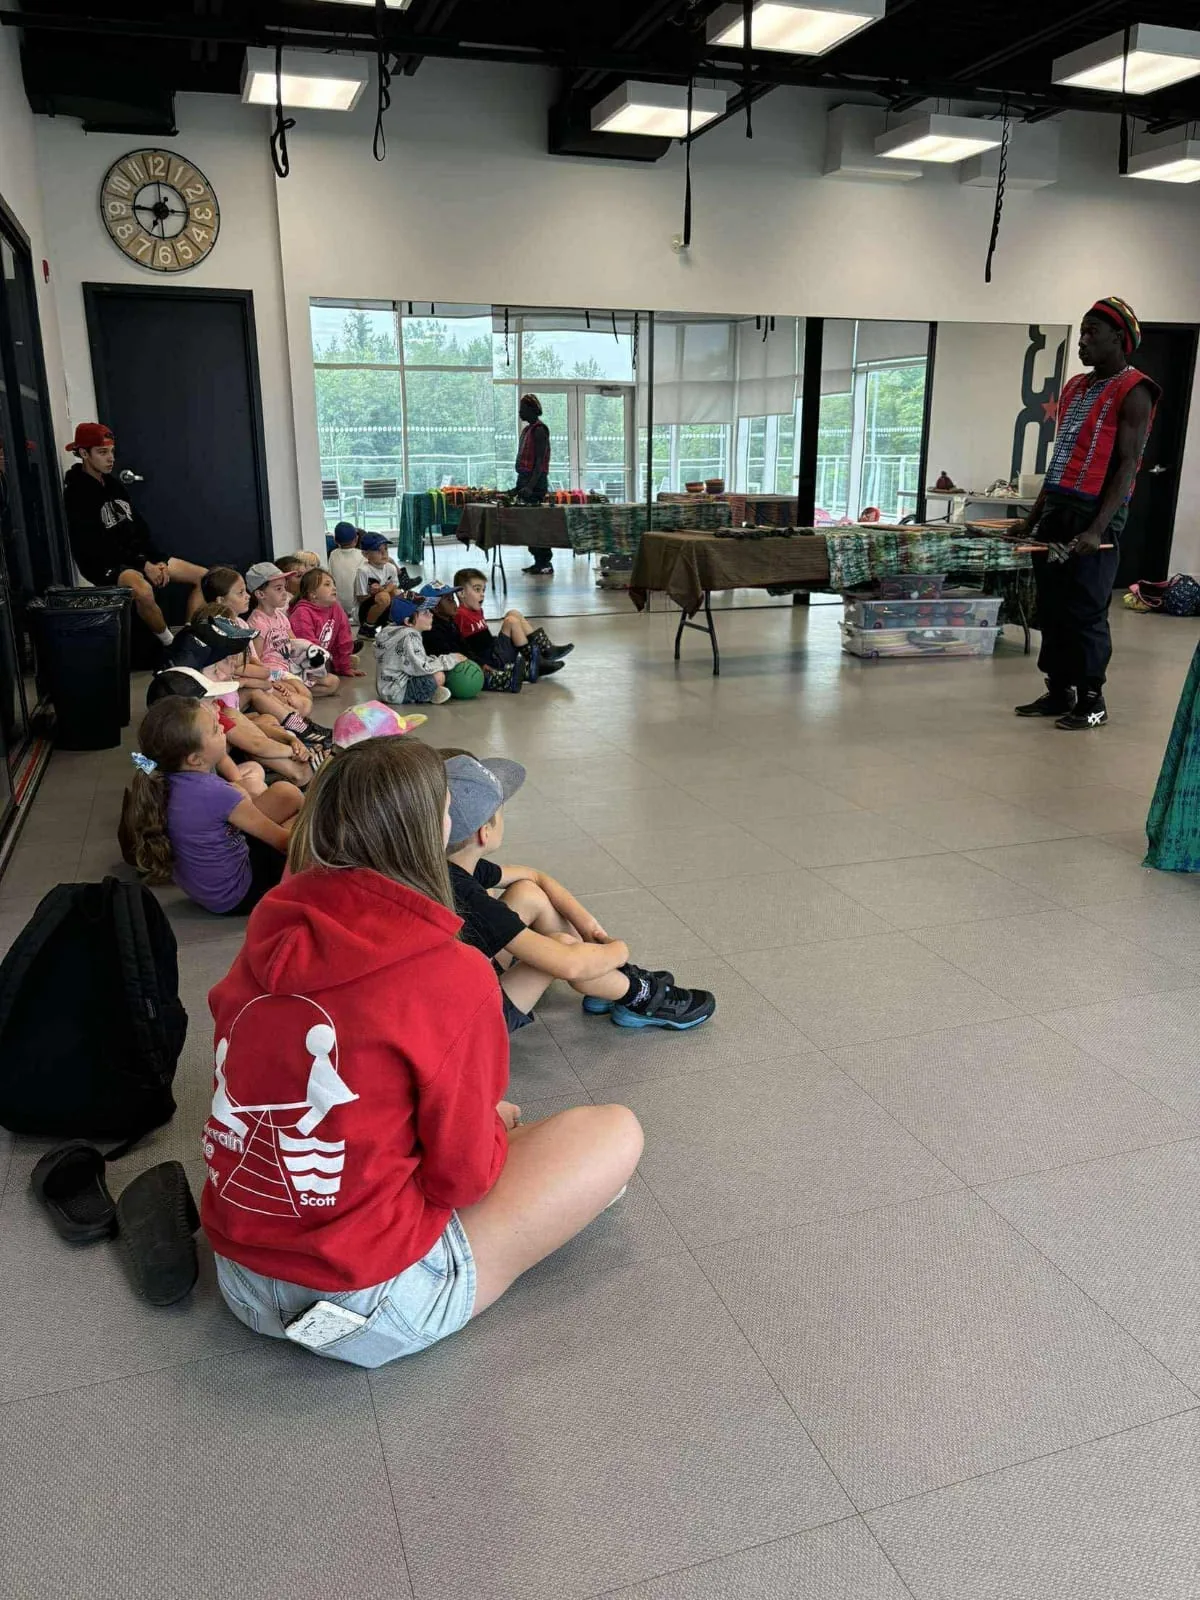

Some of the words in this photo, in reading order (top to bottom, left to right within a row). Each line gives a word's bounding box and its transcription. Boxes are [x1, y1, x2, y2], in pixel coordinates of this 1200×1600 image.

[128, 160, 144, 181] 11
[148, 156, 166, 176] 12
[174, 166, 185, 182] 1
[110, 175, 131, 196] 10
[185, 183, 205, 201] 2
[108, 201, 126, 215] 9
[194, 207, 212, 220] 3
[117, 223, 133, 239] 8
[191, 227, 209, 242] 4
[136, 238, 152, 256] 7
[159, 246, 172, 264] 6
[176, 240, 193, 259] 5
[299, 1192, 336, 1207] Scott
